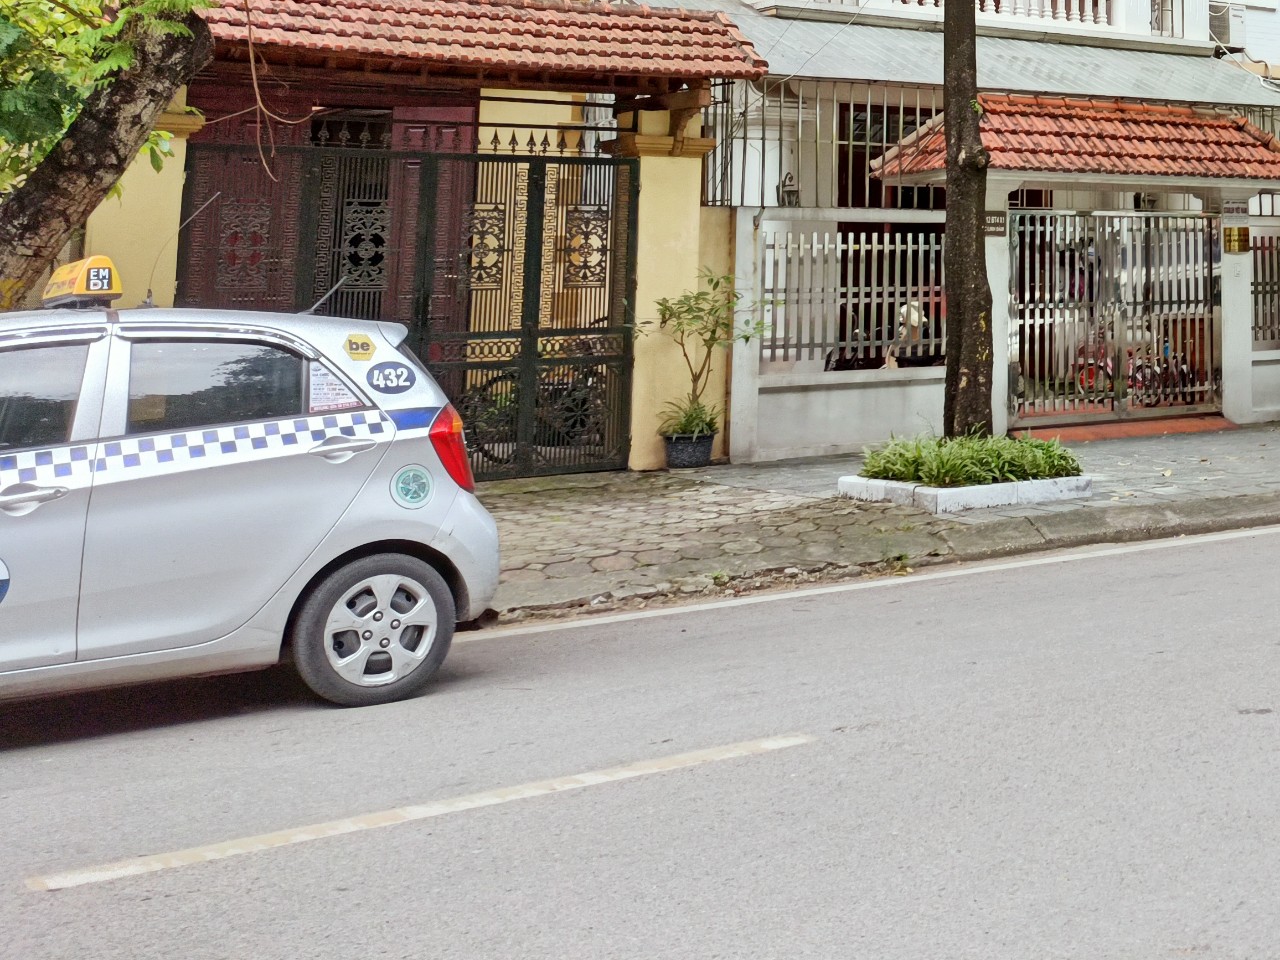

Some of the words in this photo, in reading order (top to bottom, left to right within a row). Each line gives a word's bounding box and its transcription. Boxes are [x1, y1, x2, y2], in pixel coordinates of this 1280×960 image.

[90, 268, 109, 280] EM
[89, 280, 109, 290] DI
[348, 339, 371, 352] be
[372, 367, 411, 388] 432
